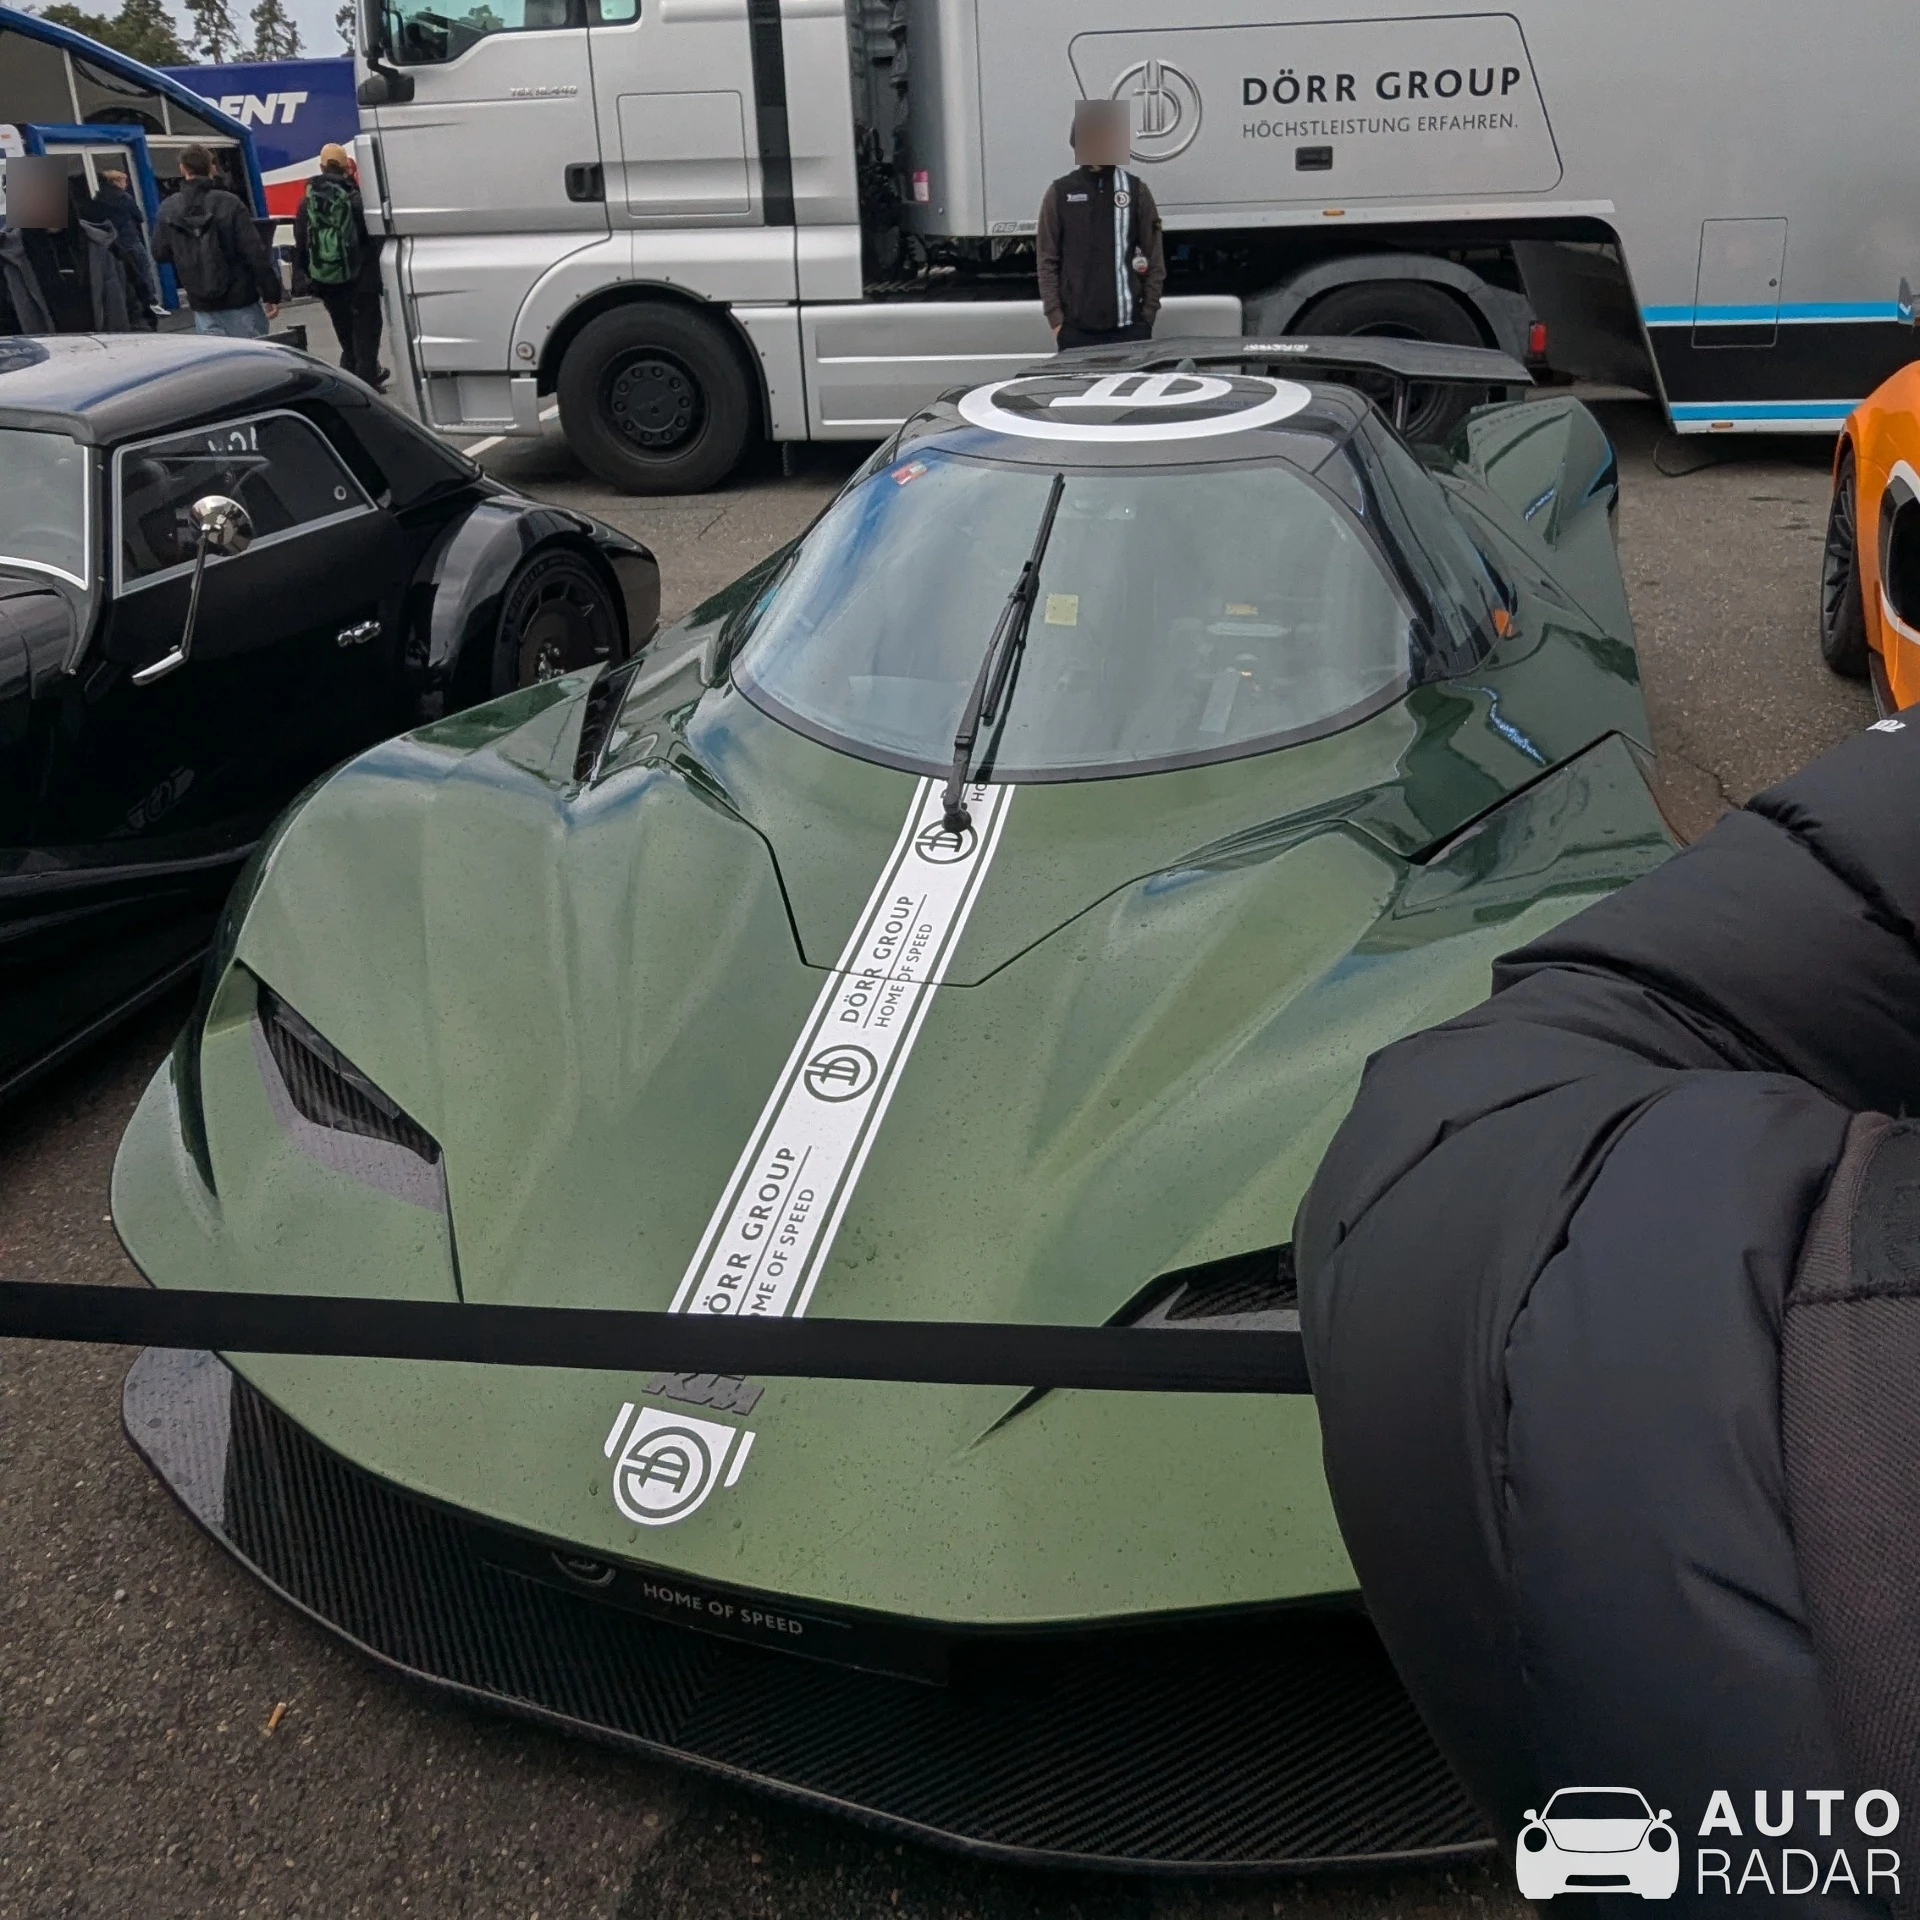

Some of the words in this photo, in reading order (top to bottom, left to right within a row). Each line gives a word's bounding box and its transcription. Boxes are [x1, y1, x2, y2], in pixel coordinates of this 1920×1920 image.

[1243, 68, 1357, 106] DÖRR
[1375, 66, 1521, 100] GROUP
[202, 91, 308, 125] ENT
[1242, 116, 1410, 138] HÖCHSTLEISTUNG
[1417, 113, 1519, 132] ERFAHREN.
[840, 967, 884, 1024] DÖRR
[873, 896, 914, 960] GROUP
[906, 923, 933, 962] SPEED
[897, 957, 916, 983] OF
[874, 985, 905, 1028] HOME
[741, 1147, 796, 1241] GROUP
[749, 1283, 776, 1316] ME
[767, 1250, 788, 1277] OF
[779, 1188, 815, 1247] SPEED
[643, 1582, 702, 1612] HOME
[708, 1601, 735, 1619] OF
[740, 1608, 803, 1635] SPEED
